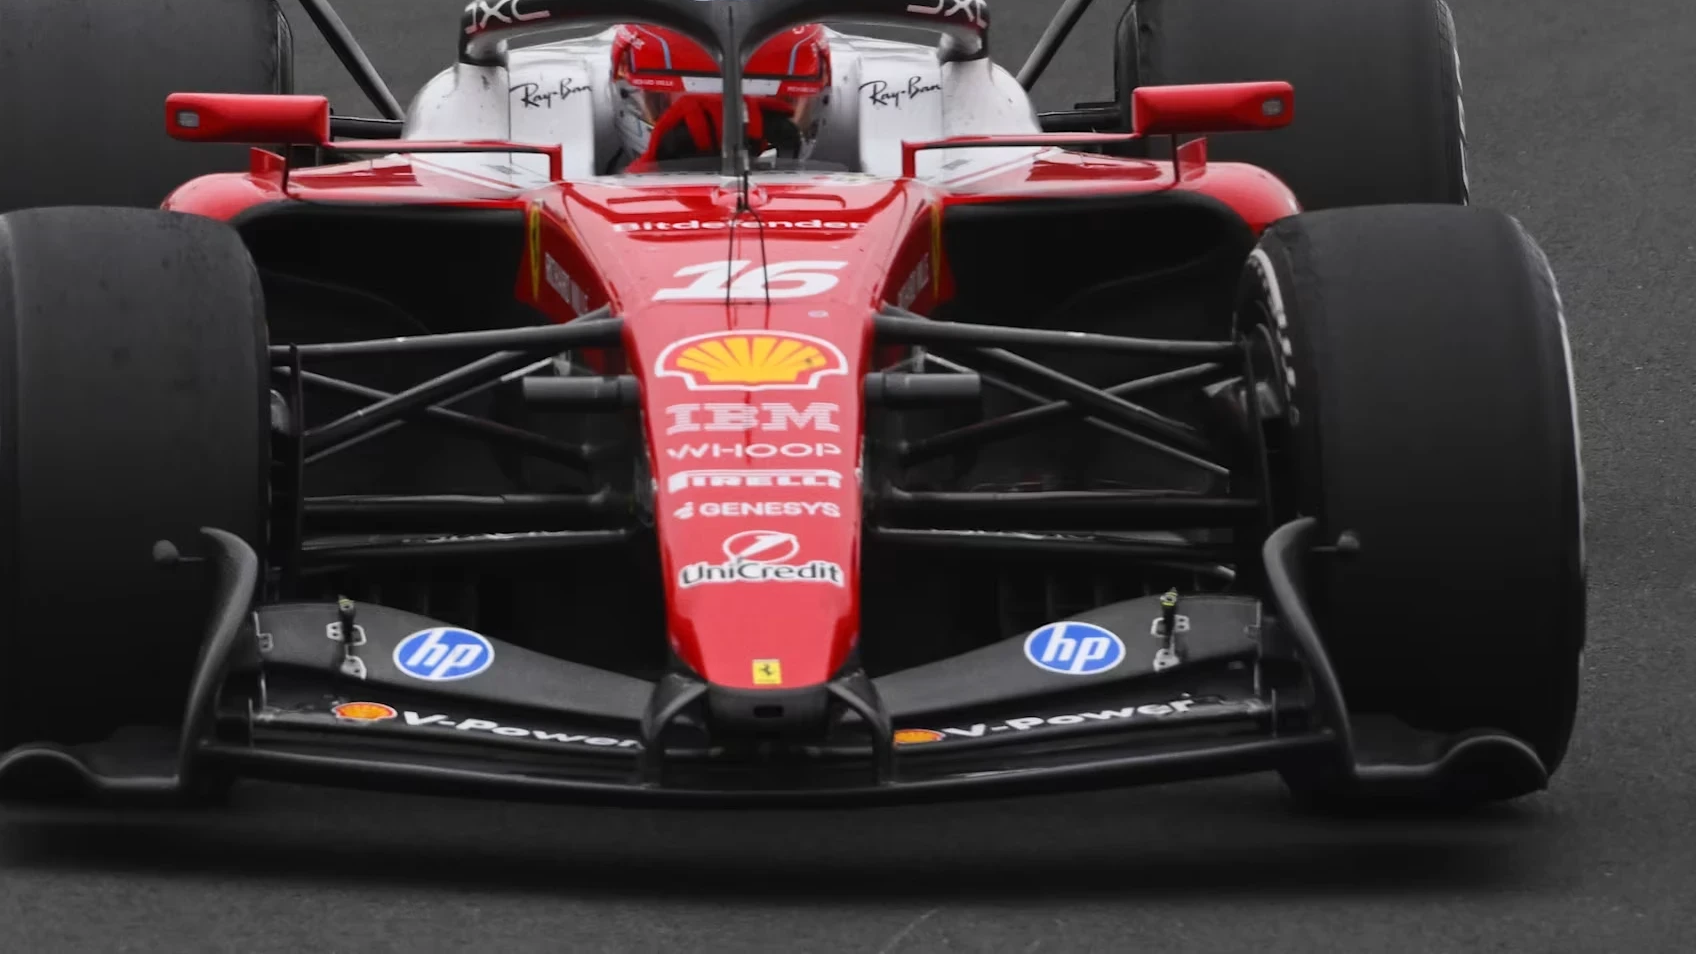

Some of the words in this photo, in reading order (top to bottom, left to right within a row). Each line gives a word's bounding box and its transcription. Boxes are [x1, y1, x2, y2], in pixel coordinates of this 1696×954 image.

[509, 78, 592, 108] Ray-Ban
[858, 76, 941, 108] Ray-Ban
[612, 220, 867, 233] Bitdefender
[651, 260, 849, 302] 16
[665, 402, 840, 435] IBM
[666, 443, 842, 459] WHOOP
[667, 469, 843, 493] PIRELLI
[698, 501, 841, 518] GENESYS
[681, 559, 840, 585] UniCredit
[406, 628, 481, 680] hp
[1042, 622, 1110, 674] hp
[403, 710, 645, 750] V-Power
[943, 696, 1194, 738] V-Power
